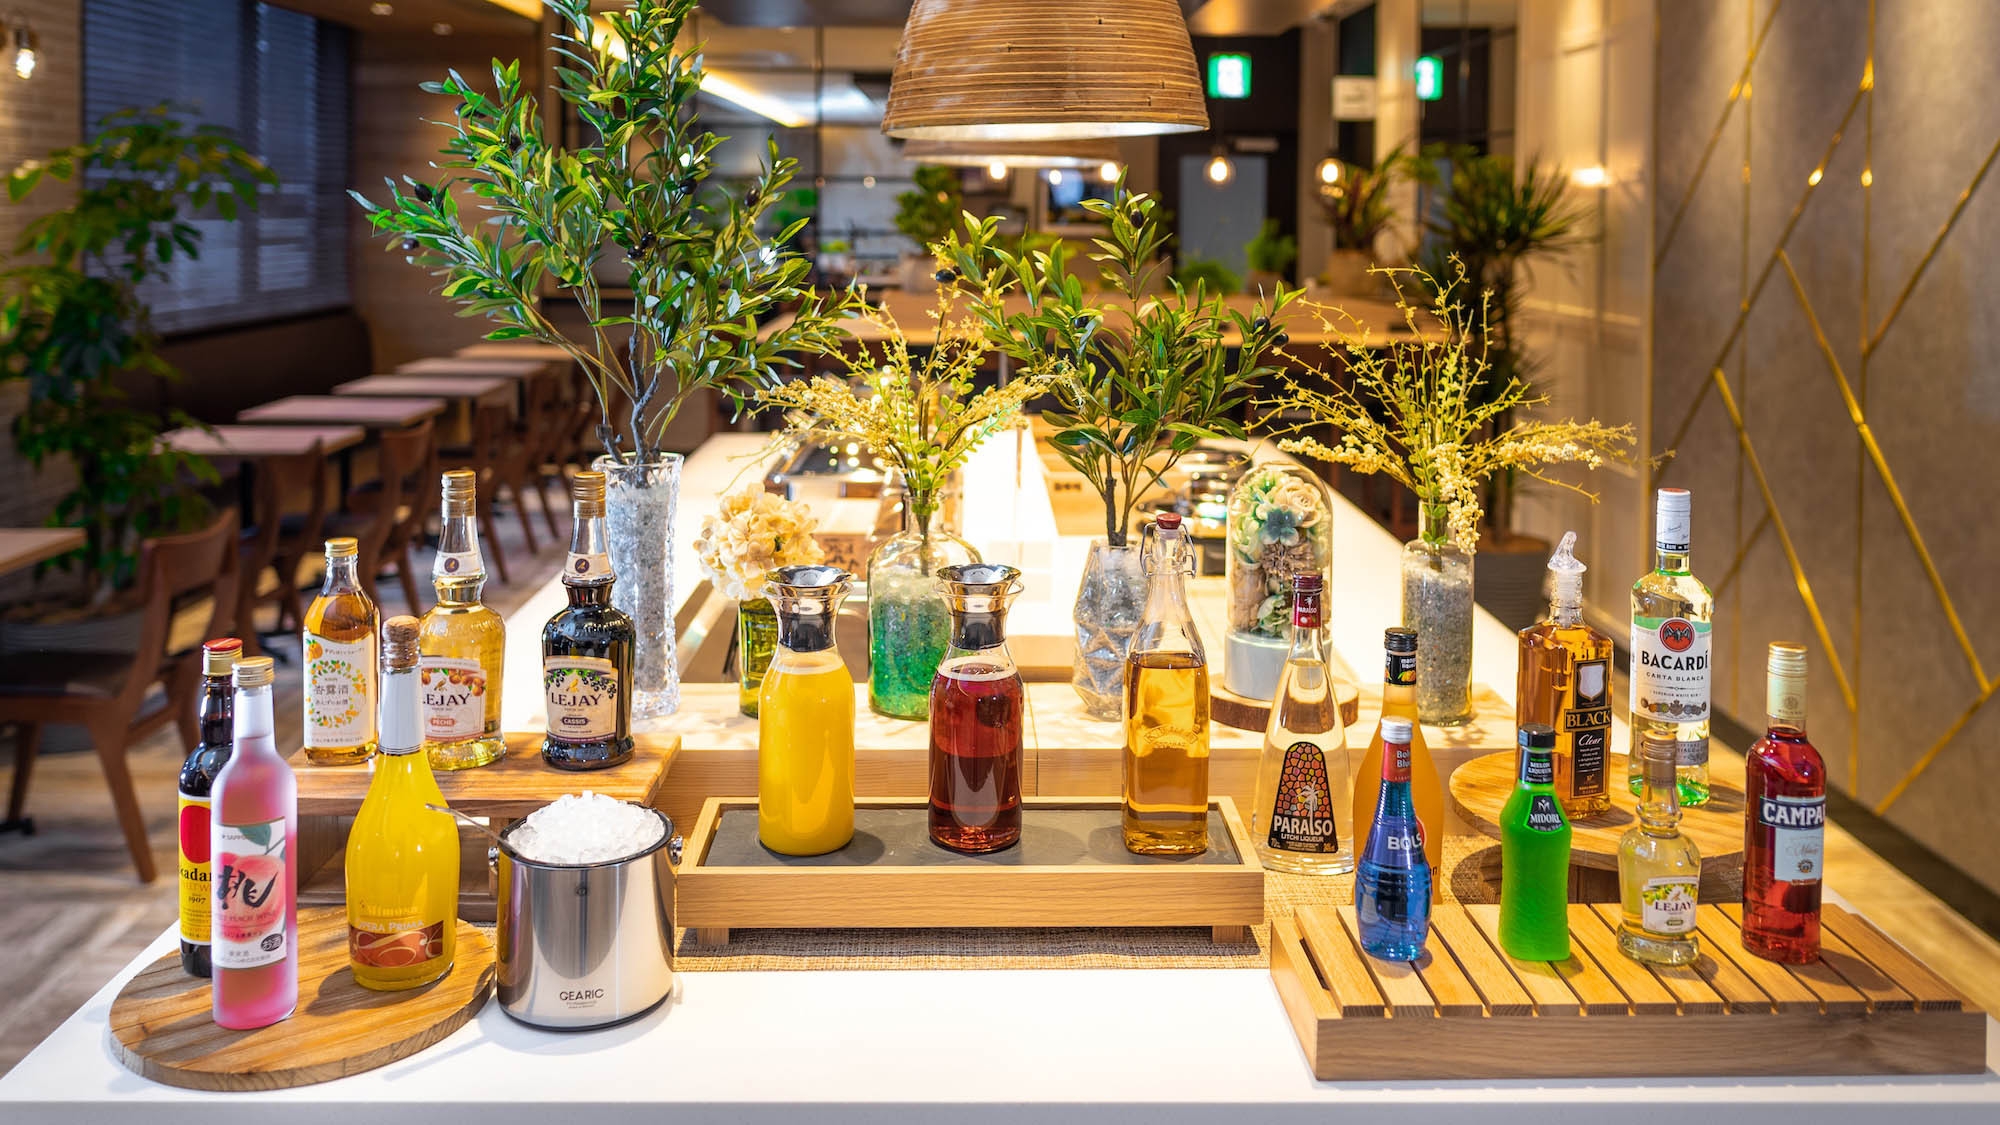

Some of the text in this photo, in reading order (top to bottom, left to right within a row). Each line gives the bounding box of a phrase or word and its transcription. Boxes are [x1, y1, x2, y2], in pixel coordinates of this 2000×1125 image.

[1641, 650, 1708, 671] BACARDÍ
[1646, 671, 1672, 681] CARTA
[551, 692, 602, 707] LEJAY
[1566, 710, 1611, 728] BLACK
[1578, 734, 1602, 746] Clear
[1273, 815, 1333, 836] PARAISO
[1530, 813, 1561, 824] MIDORI
[1281, 833, 1299, 841] LITCHI
[1388, 835, 1422, 850] BOLS
[216, 865, 279, 910] 桃
[1655, 901, 1692, 911] LEJAY
[261, 935, 283, 951] お酒
[559, 988, 604, 1001] GEARIC
